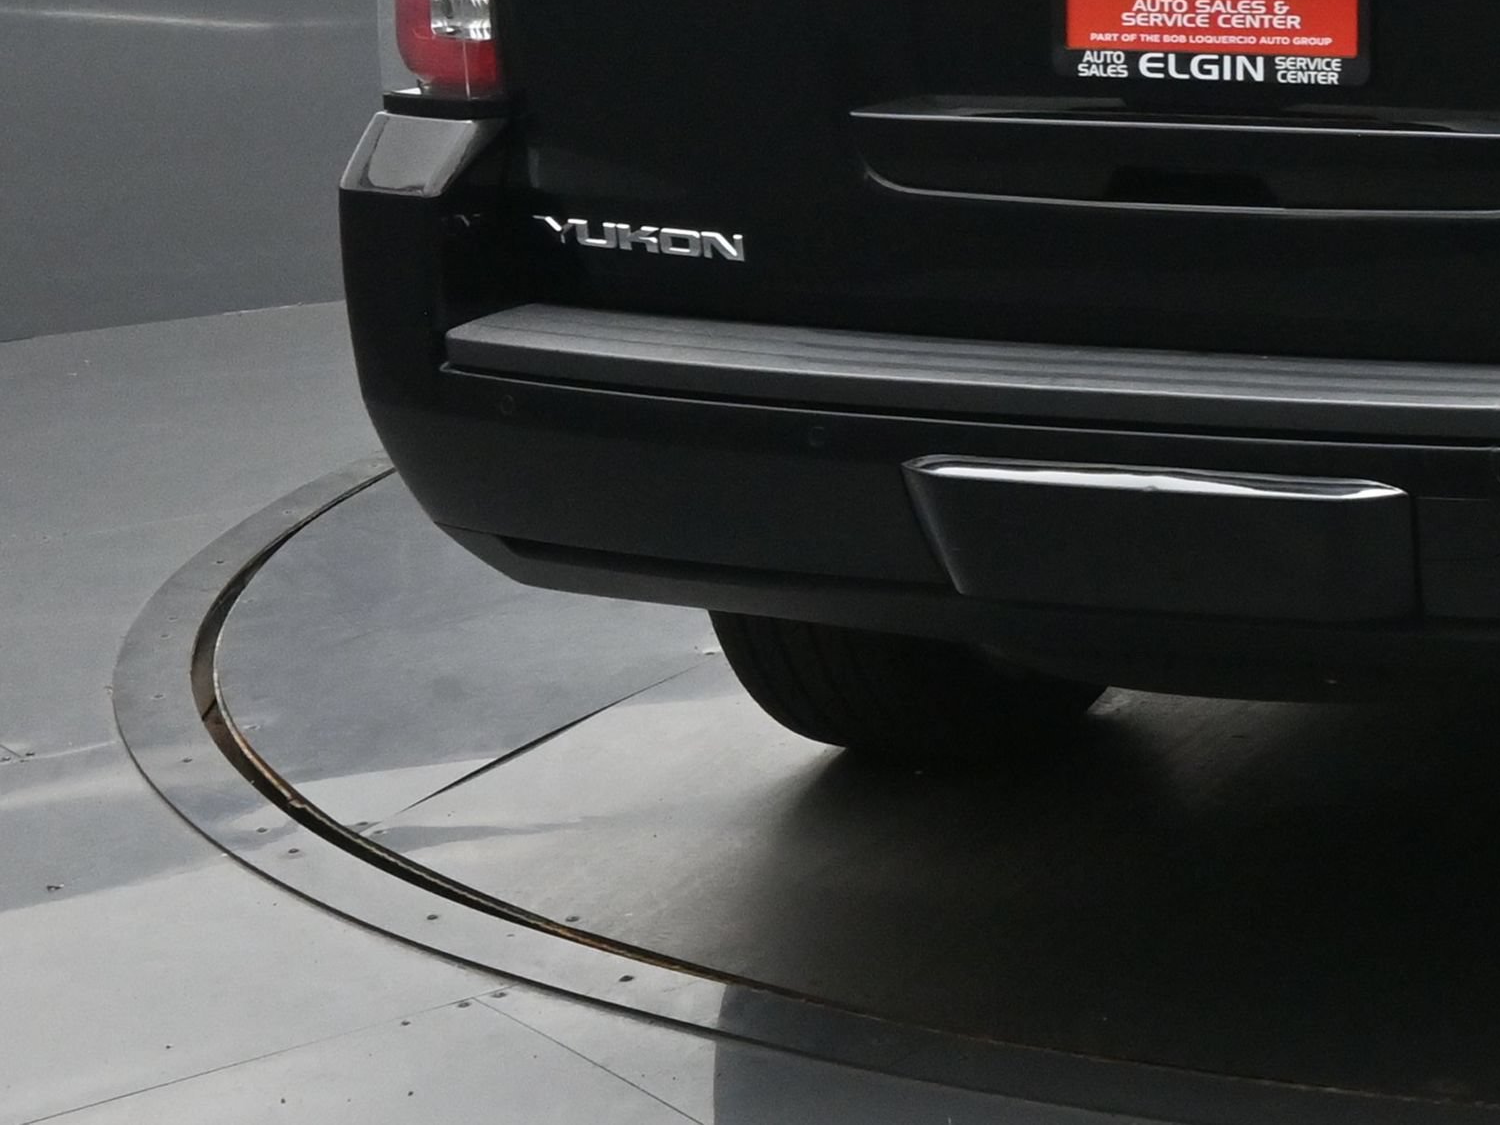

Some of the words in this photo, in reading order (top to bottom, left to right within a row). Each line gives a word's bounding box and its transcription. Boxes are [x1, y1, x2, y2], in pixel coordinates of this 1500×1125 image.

[1132, 0, 1187, 13] AUTO
[1195, 0, 1266, 14] SALES
[1274, 1, 1289, 14] &
[1122, 13, 1209, 27] SERVICE
[1218, 14, 1300, 29] CENTER
[1090, 32, 1119, 42] PART
[1121, 33, 1137, 42] OF
[1140, 33, 1160, 43] THE
[1163, 34, 1186, 44] BOB
[1189, 34, 1256, 45] LOQUERCIO
[1259, 36, 1290, 46] AUTO
[1292, 36, 1332, 46] GROUP
[1083, 51, 1124, 64] AUTO
[1275, 57, 1341, 72] SERVICE
[1078, 64, 1128, 77] SALES
[1139, 53, 1264, 81] ELGIN
[1277, 71, 1338, 84] CENTER
[532, 215, 745, 262] YUKON
